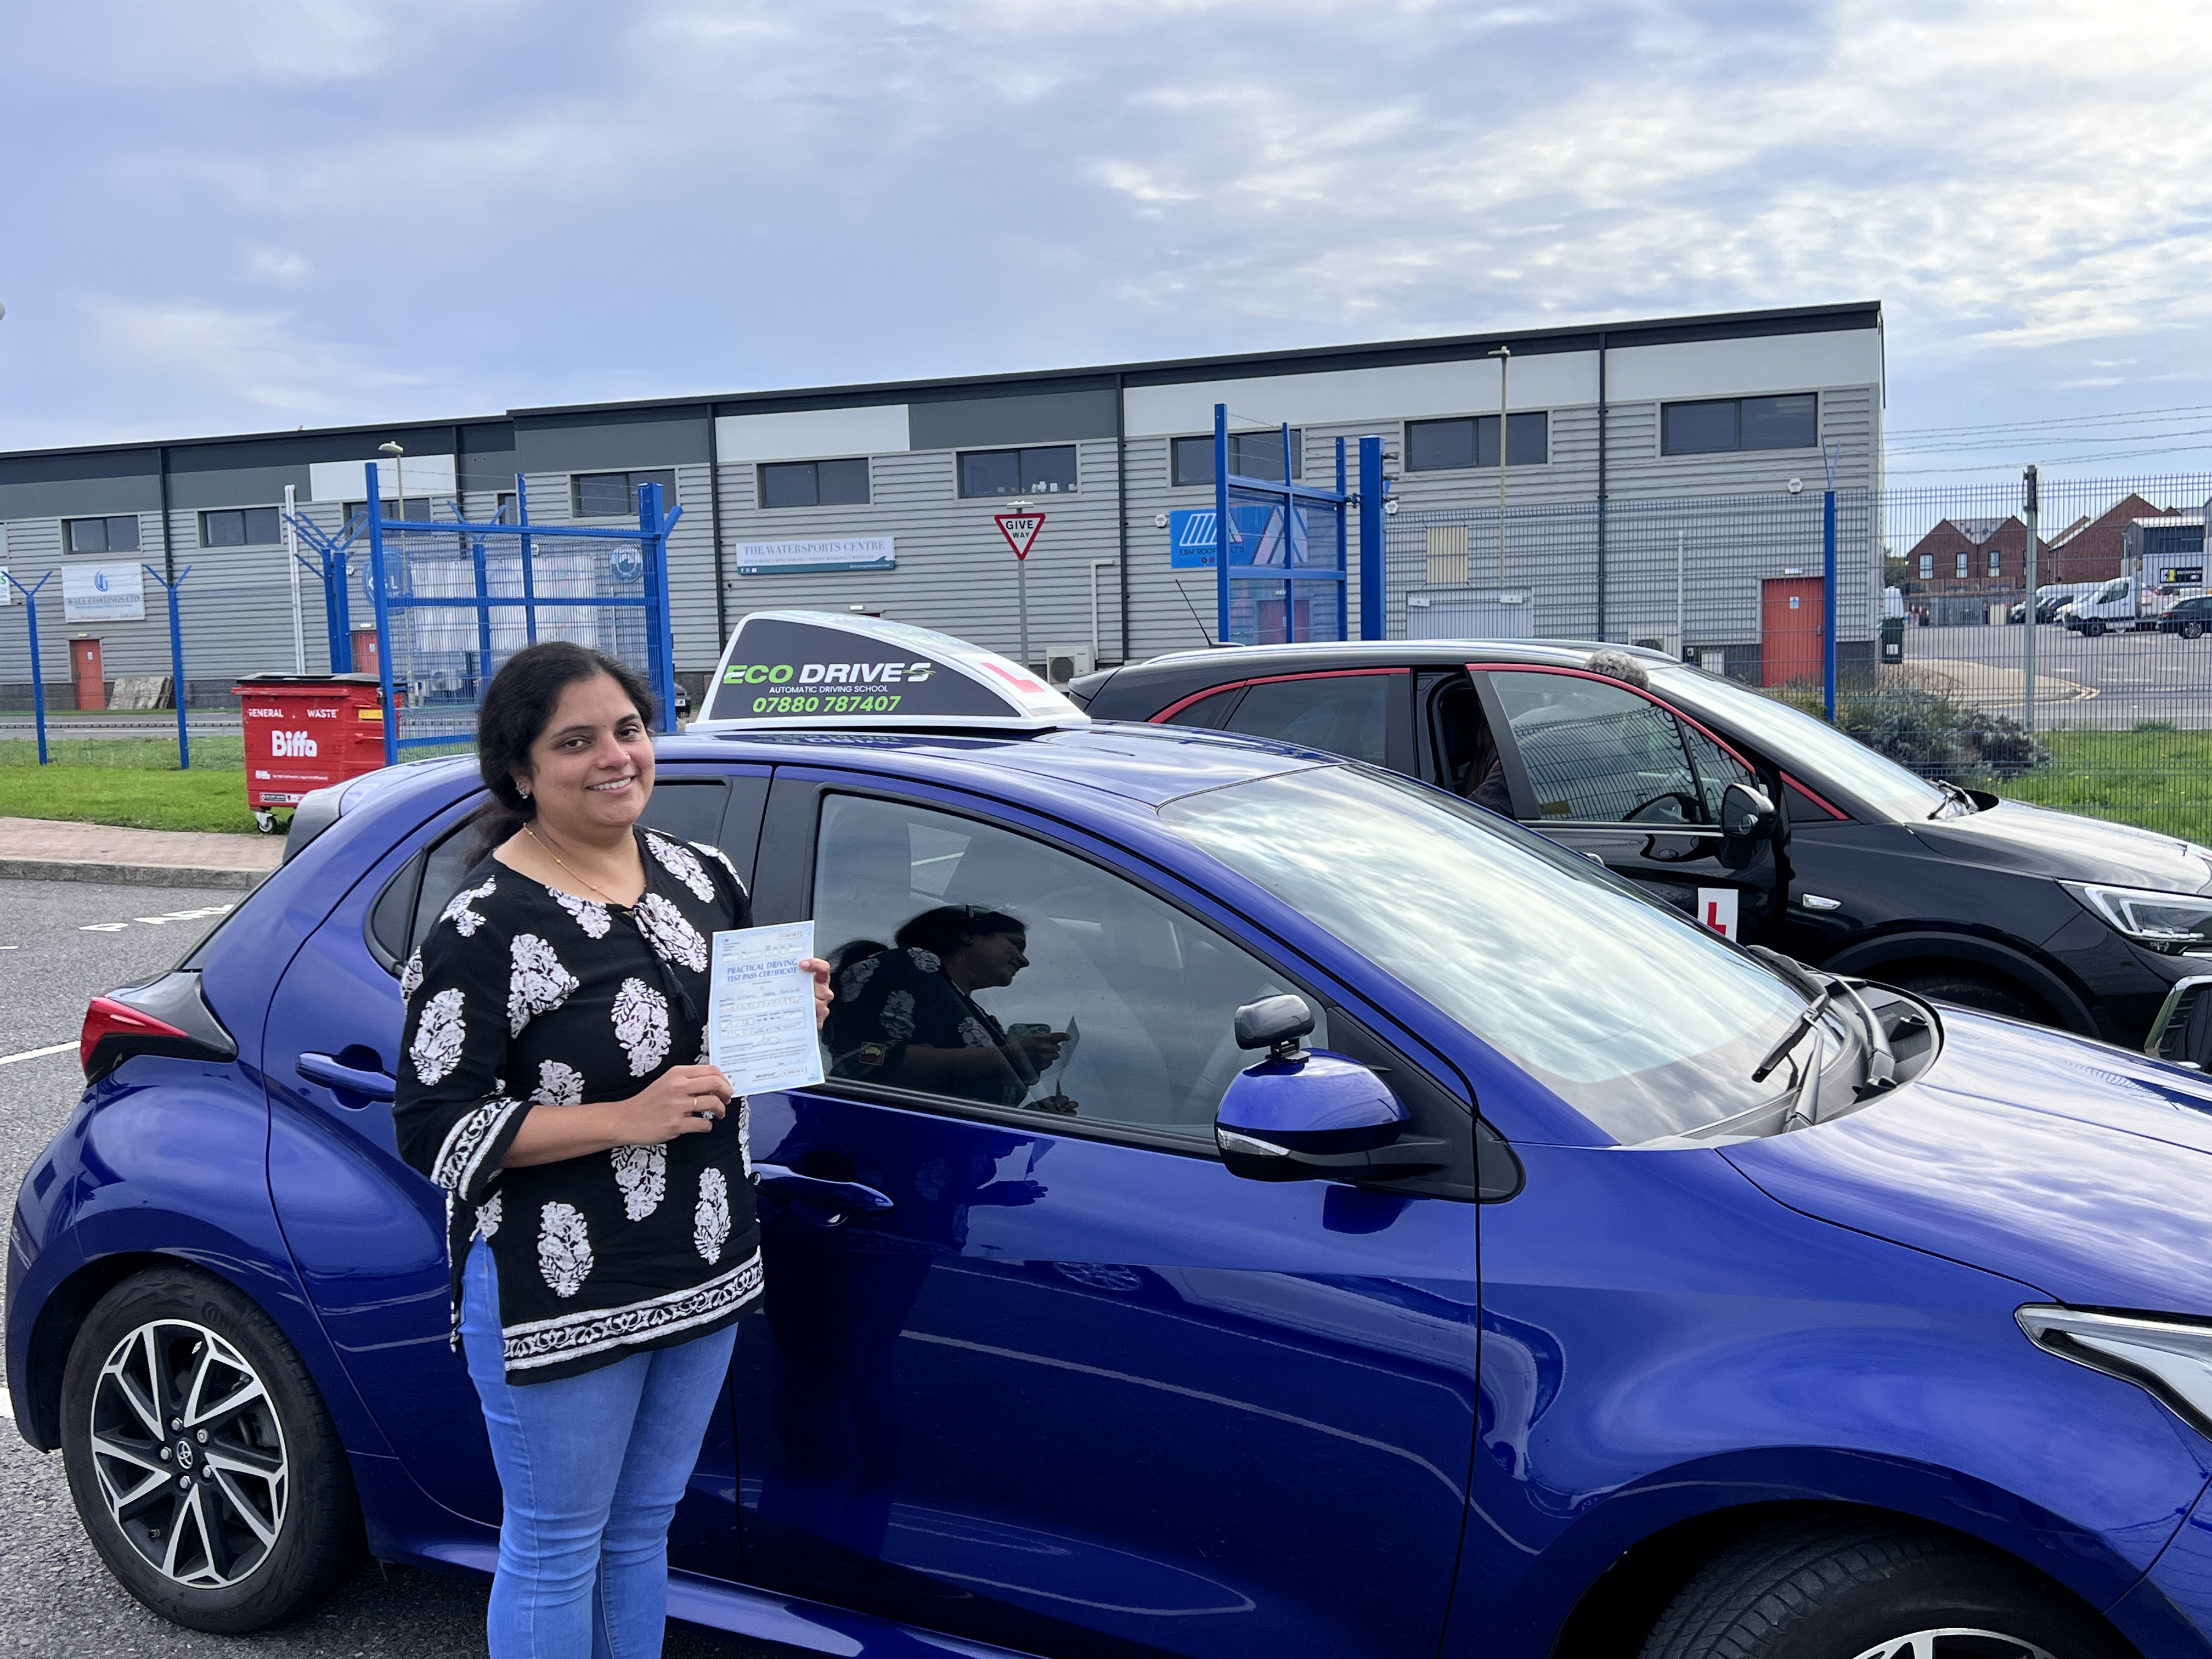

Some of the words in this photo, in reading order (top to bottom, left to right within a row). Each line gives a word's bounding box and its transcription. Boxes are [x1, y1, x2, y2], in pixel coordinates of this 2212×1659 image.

[1006, 520, 1034, 529] GIVE
[743, 546, 764, 555] THE
[766, 543, 840, 554] WATERSPORTS
[844, 540, 885, 551] CENTRE
[723, 664, 794, 684] ECO
[799, 663, 932, 684] DRIVES
[769, 686, 817, 694] AUTOMATIC
[753, 696, 819, 713] 07880
[823, 696, 901, 712] 787407
[247, 708, 284, 718] GENERAL
[307, 708, 337, 718] WASTE
[272, 730, 317, 757] Biffa
[1707, 902, 1726, 935] L
[727, 963, 764, 974] PRACTICAL
[767, 958, 798, 969] DRIVING
[759, 967, 797, 978] CERTIFICATE
